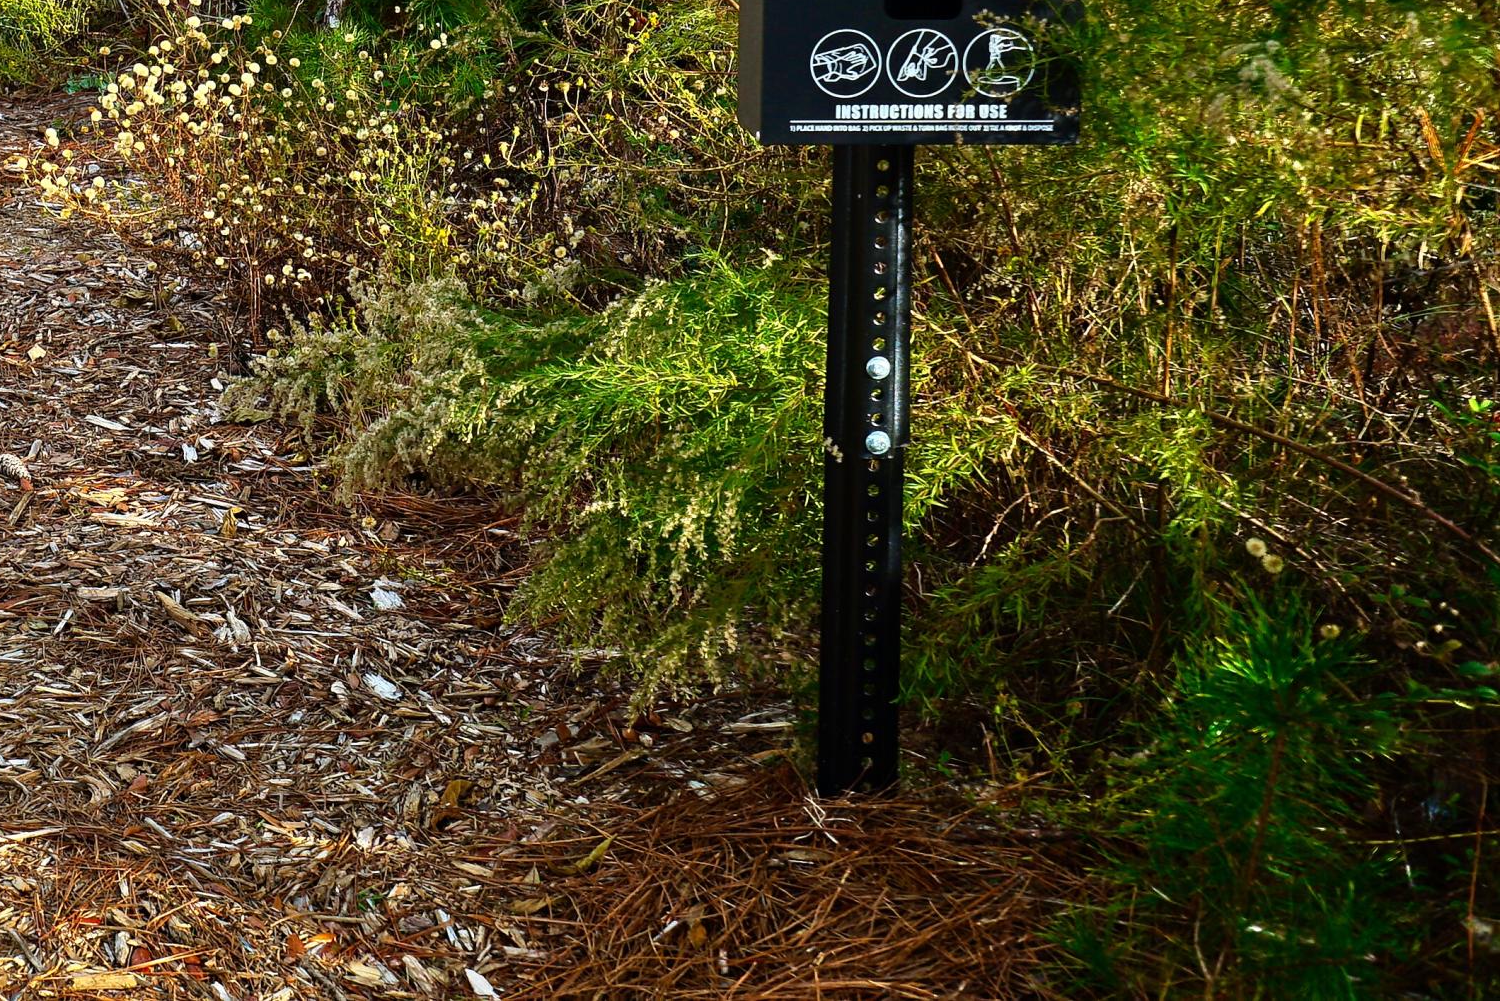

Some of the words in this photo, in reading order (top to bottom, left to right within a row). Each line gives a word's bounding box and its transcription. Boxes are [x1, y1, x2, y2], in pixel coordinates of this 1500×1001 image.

[835, 104, 944, 120] INSTRUCTIONS
[947, 104, 975, 119] FOR
[979, 104, 1007, 119] USE
